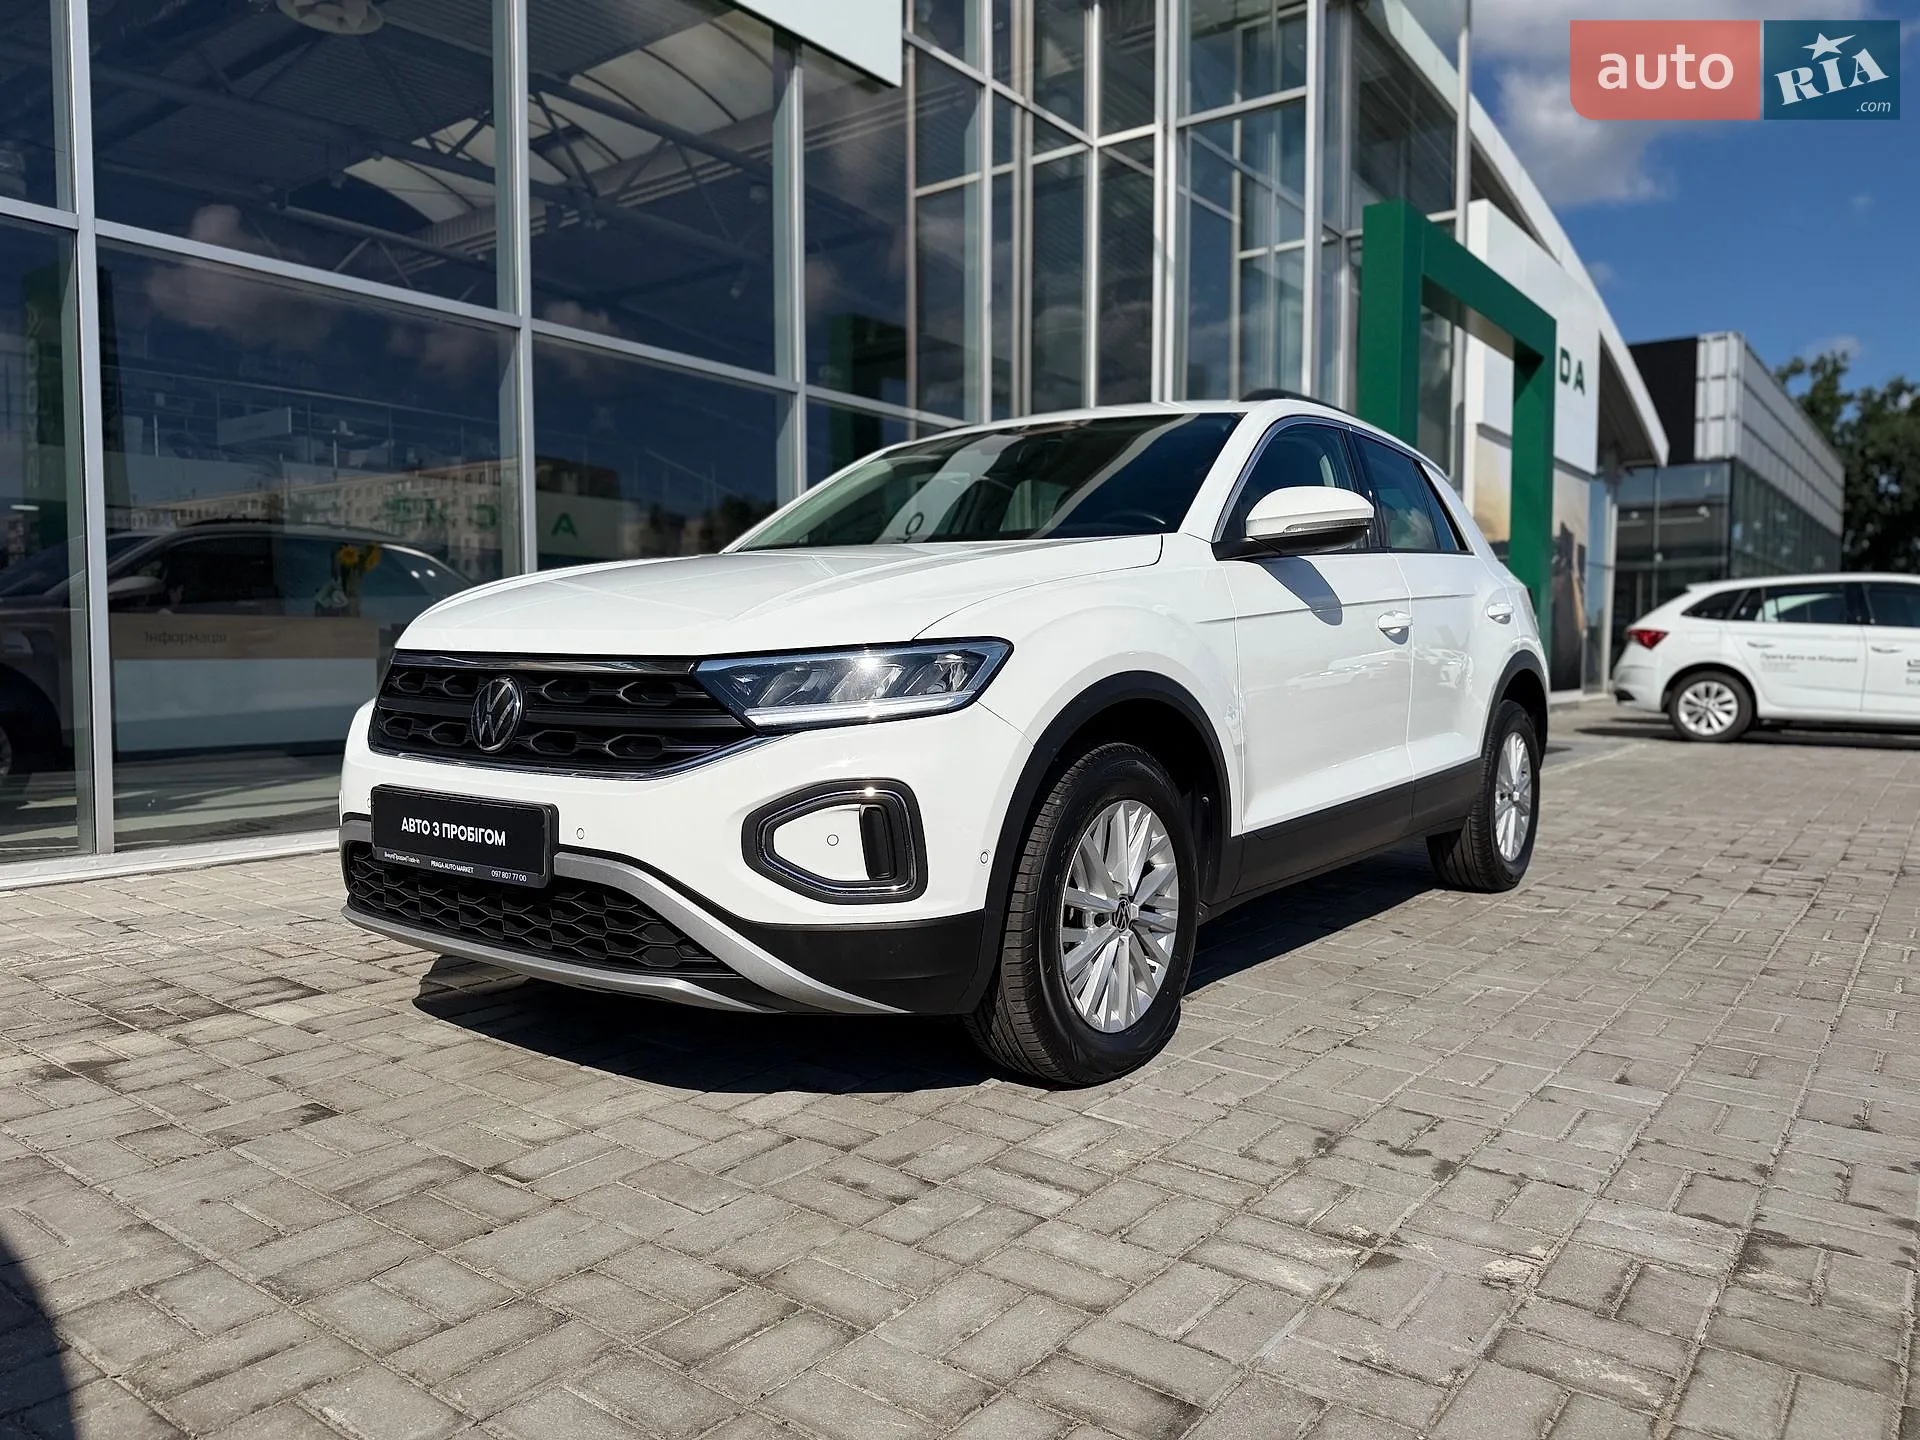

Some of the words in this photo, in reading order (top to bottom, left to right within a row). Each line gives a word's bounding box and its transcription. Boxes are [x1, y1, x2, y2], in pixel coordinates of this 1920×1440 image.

[401, 817, 431, 835] АВТО
[442, 823, 506, 847] ПРОБІГОМ
[444, 862, 456, 871] AUTO
[457, 865, 474, 874] MARKET
[491, 869, 501, 877] 097
[501, 871, 511, 879] 807
[519, 874, 527, 882] 00
